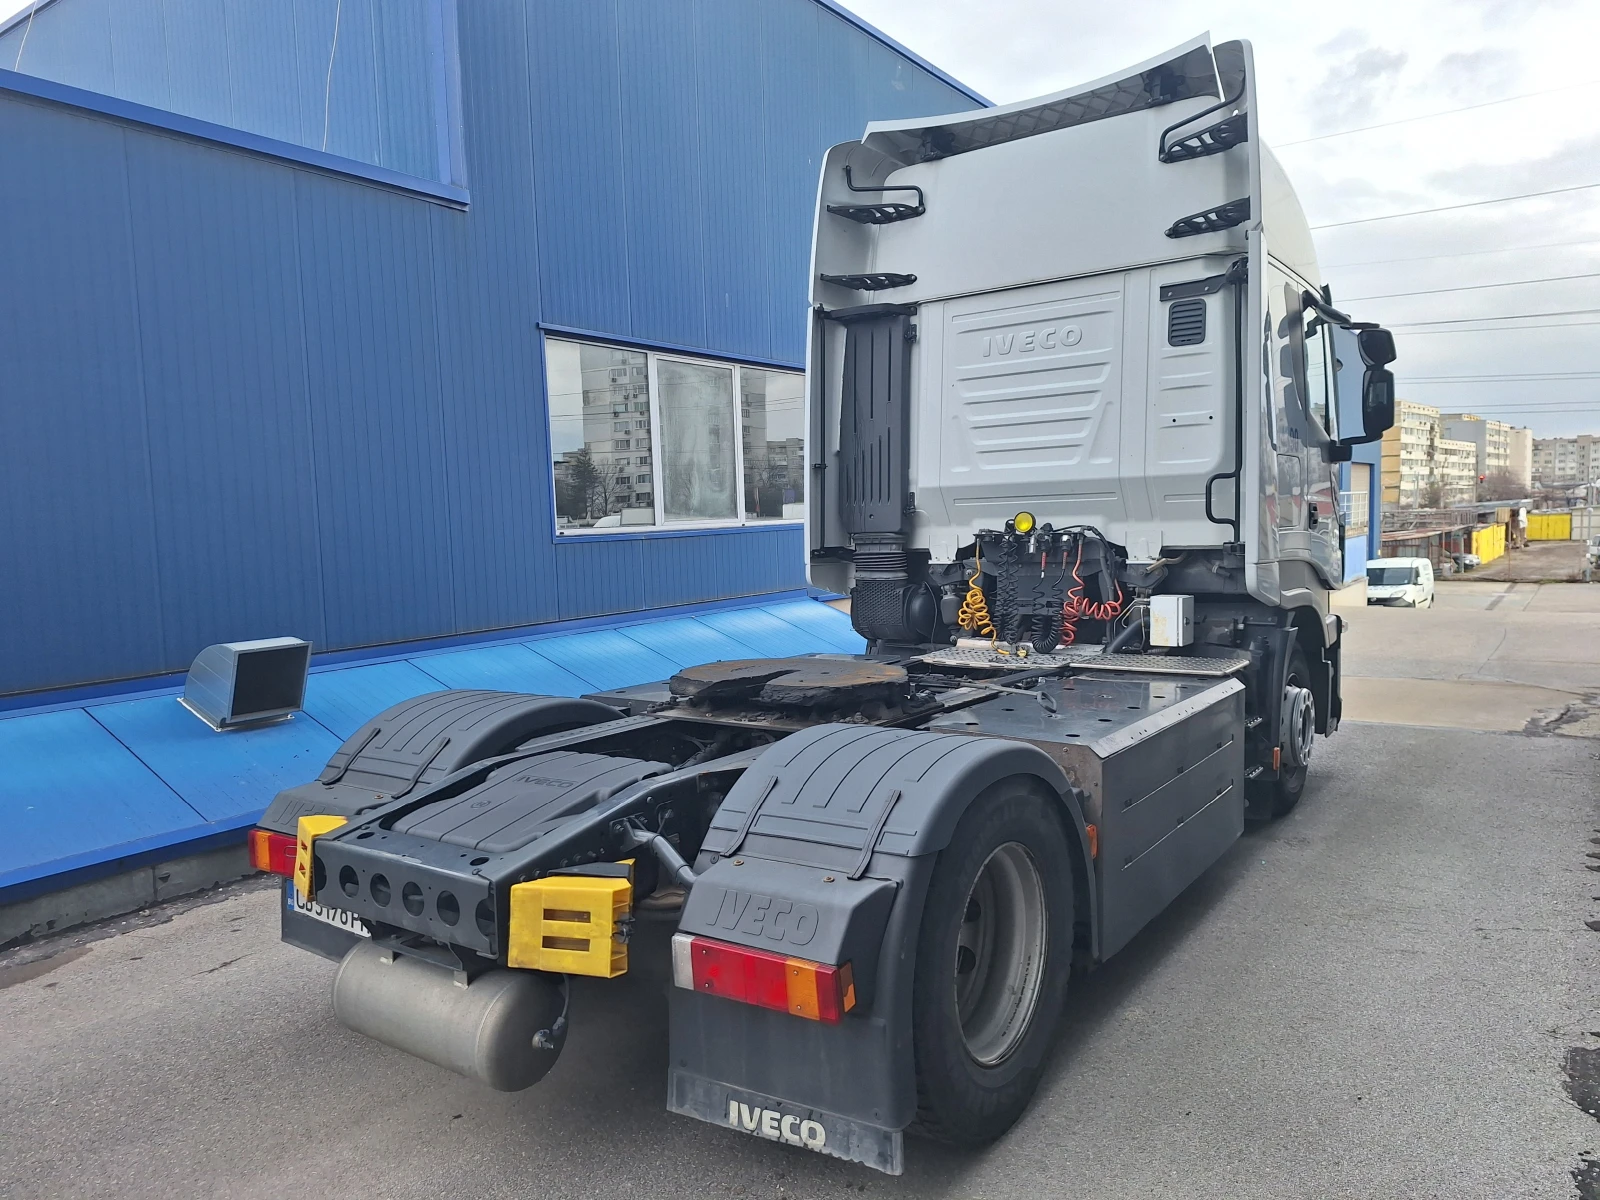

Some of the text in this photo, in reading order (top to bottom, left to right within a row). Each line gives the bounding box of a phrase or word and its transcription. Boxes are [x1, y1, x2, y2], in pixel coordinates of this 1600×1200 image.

[983, 325, 1082, 357] IVECO
[513, 775, 576, 788] IVECO
[705, 887, 819, 946] IVECO
[729, 1100, 826, 1148] IVECO
